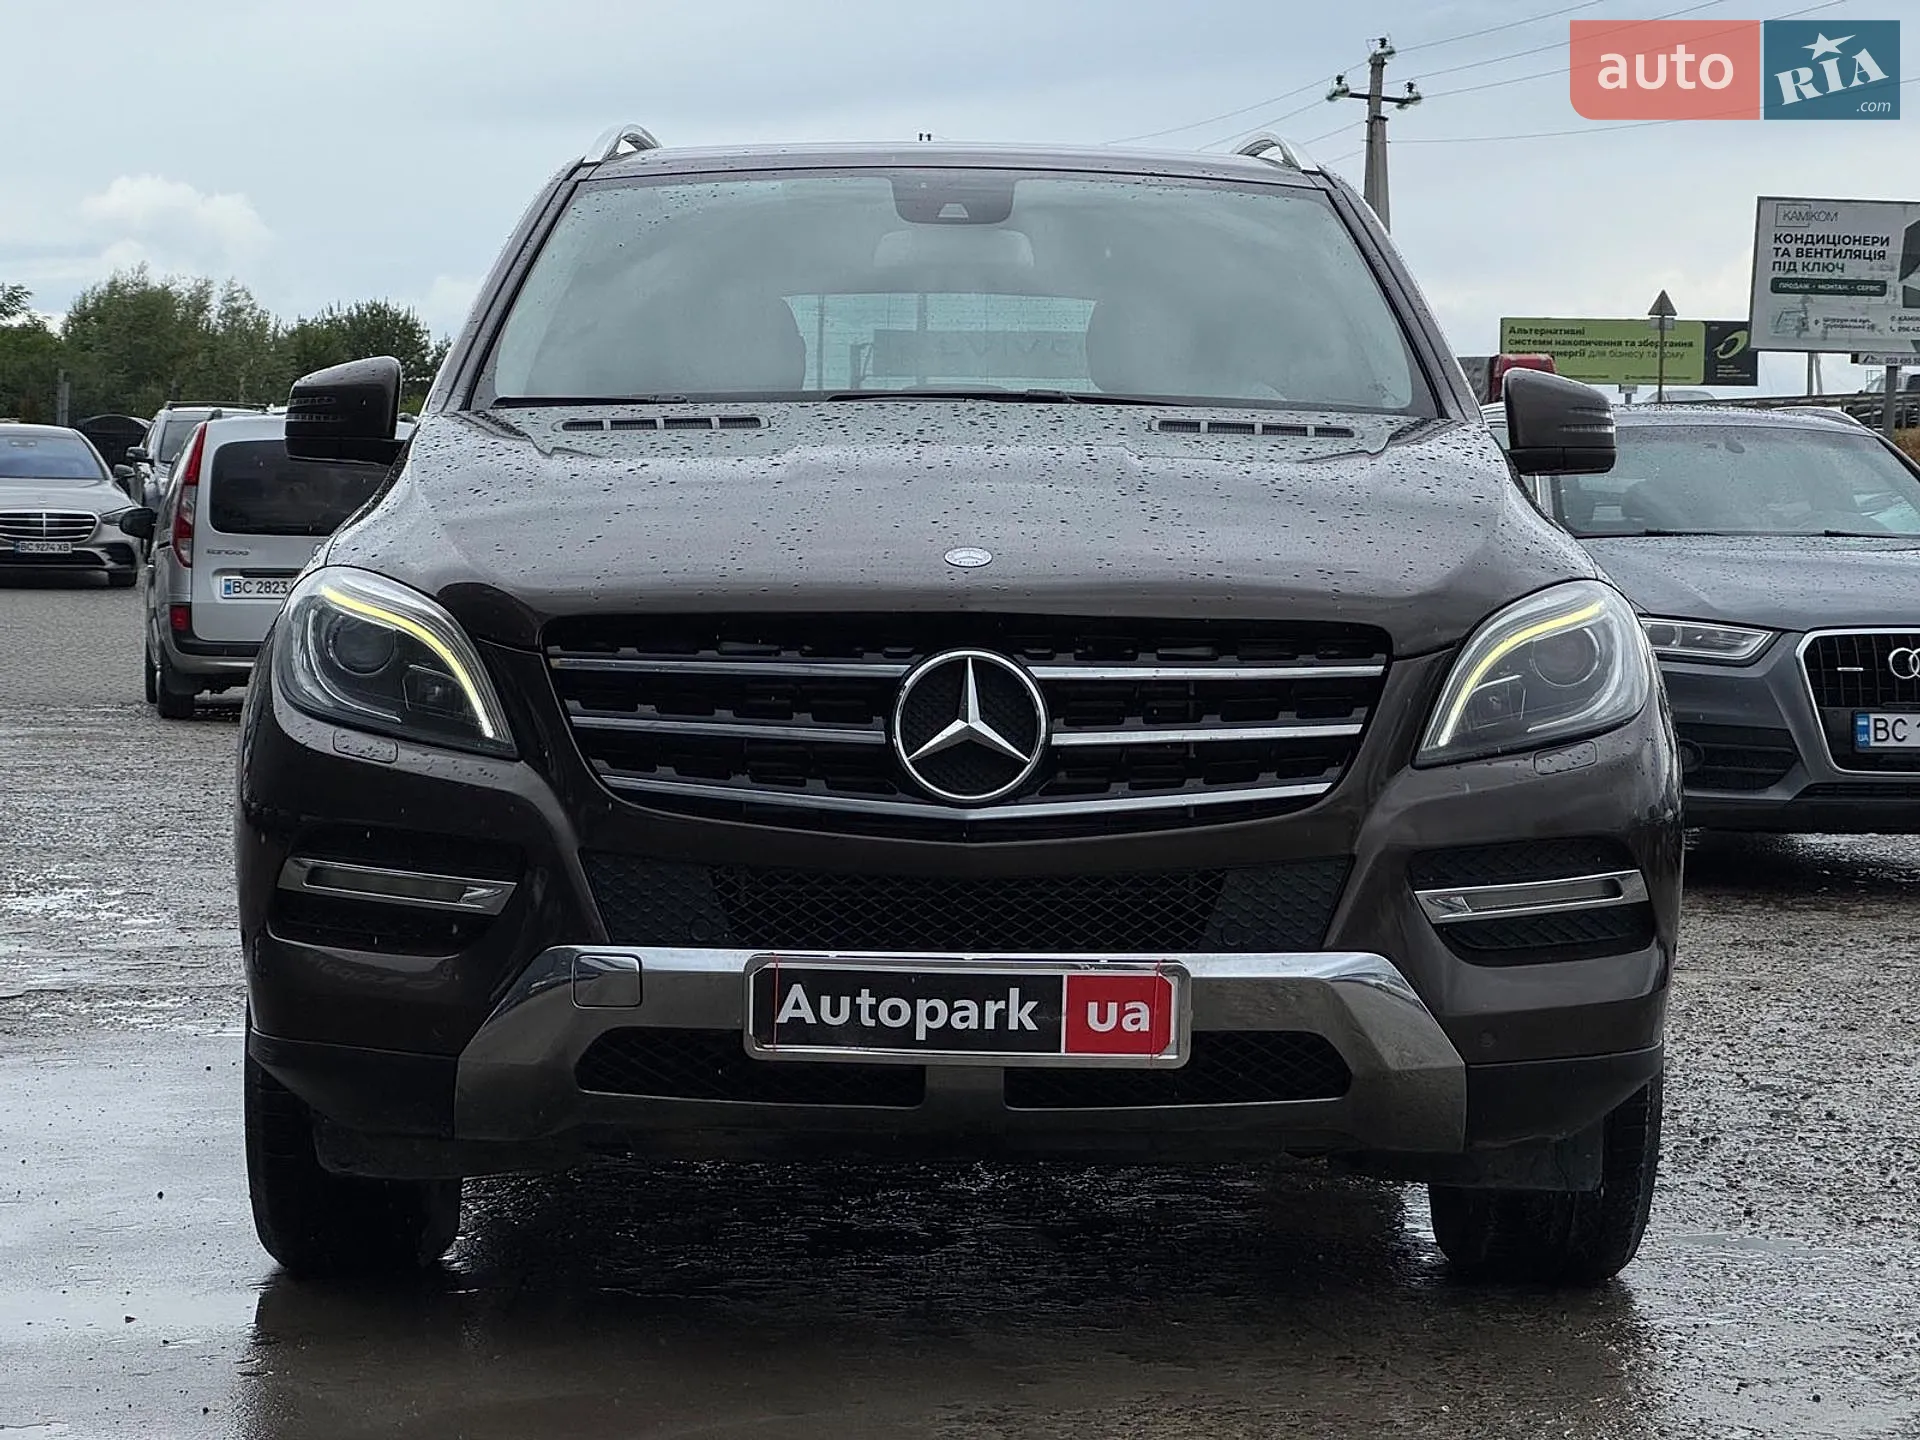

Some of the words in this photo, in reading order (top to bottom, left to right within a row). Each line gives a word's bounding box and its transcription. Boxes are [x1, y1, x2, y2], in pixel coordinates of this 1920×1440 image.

[1773, 233, 1890, 247] КОНДИЦІОНЕРИ
[1773, 247, 1791, 258] ТА
[1795, 248, 1887, 262] ВЕНТИЛЯЦІЯ
[1772, 261, 1798, 273] ПІД
[1801, 262, 1846, 273] КЛЮЧ
[1508, 326, 1585, 337] Альтернативні
[1508, 338, 1553, 347] системи
[1555, 339, 1622, 348] накопичення
[1625, 340, 1636, 348] та
[1638, 338, 1694, 350] збергання
[232, 580, 253, 594] BC
[255, 580, 288, 594] 2823
[1873, 717, 1908, 742] BC
[775, 983, 1039, 1041] Autopark
[1086, 1001, 1150, 1032] ua
